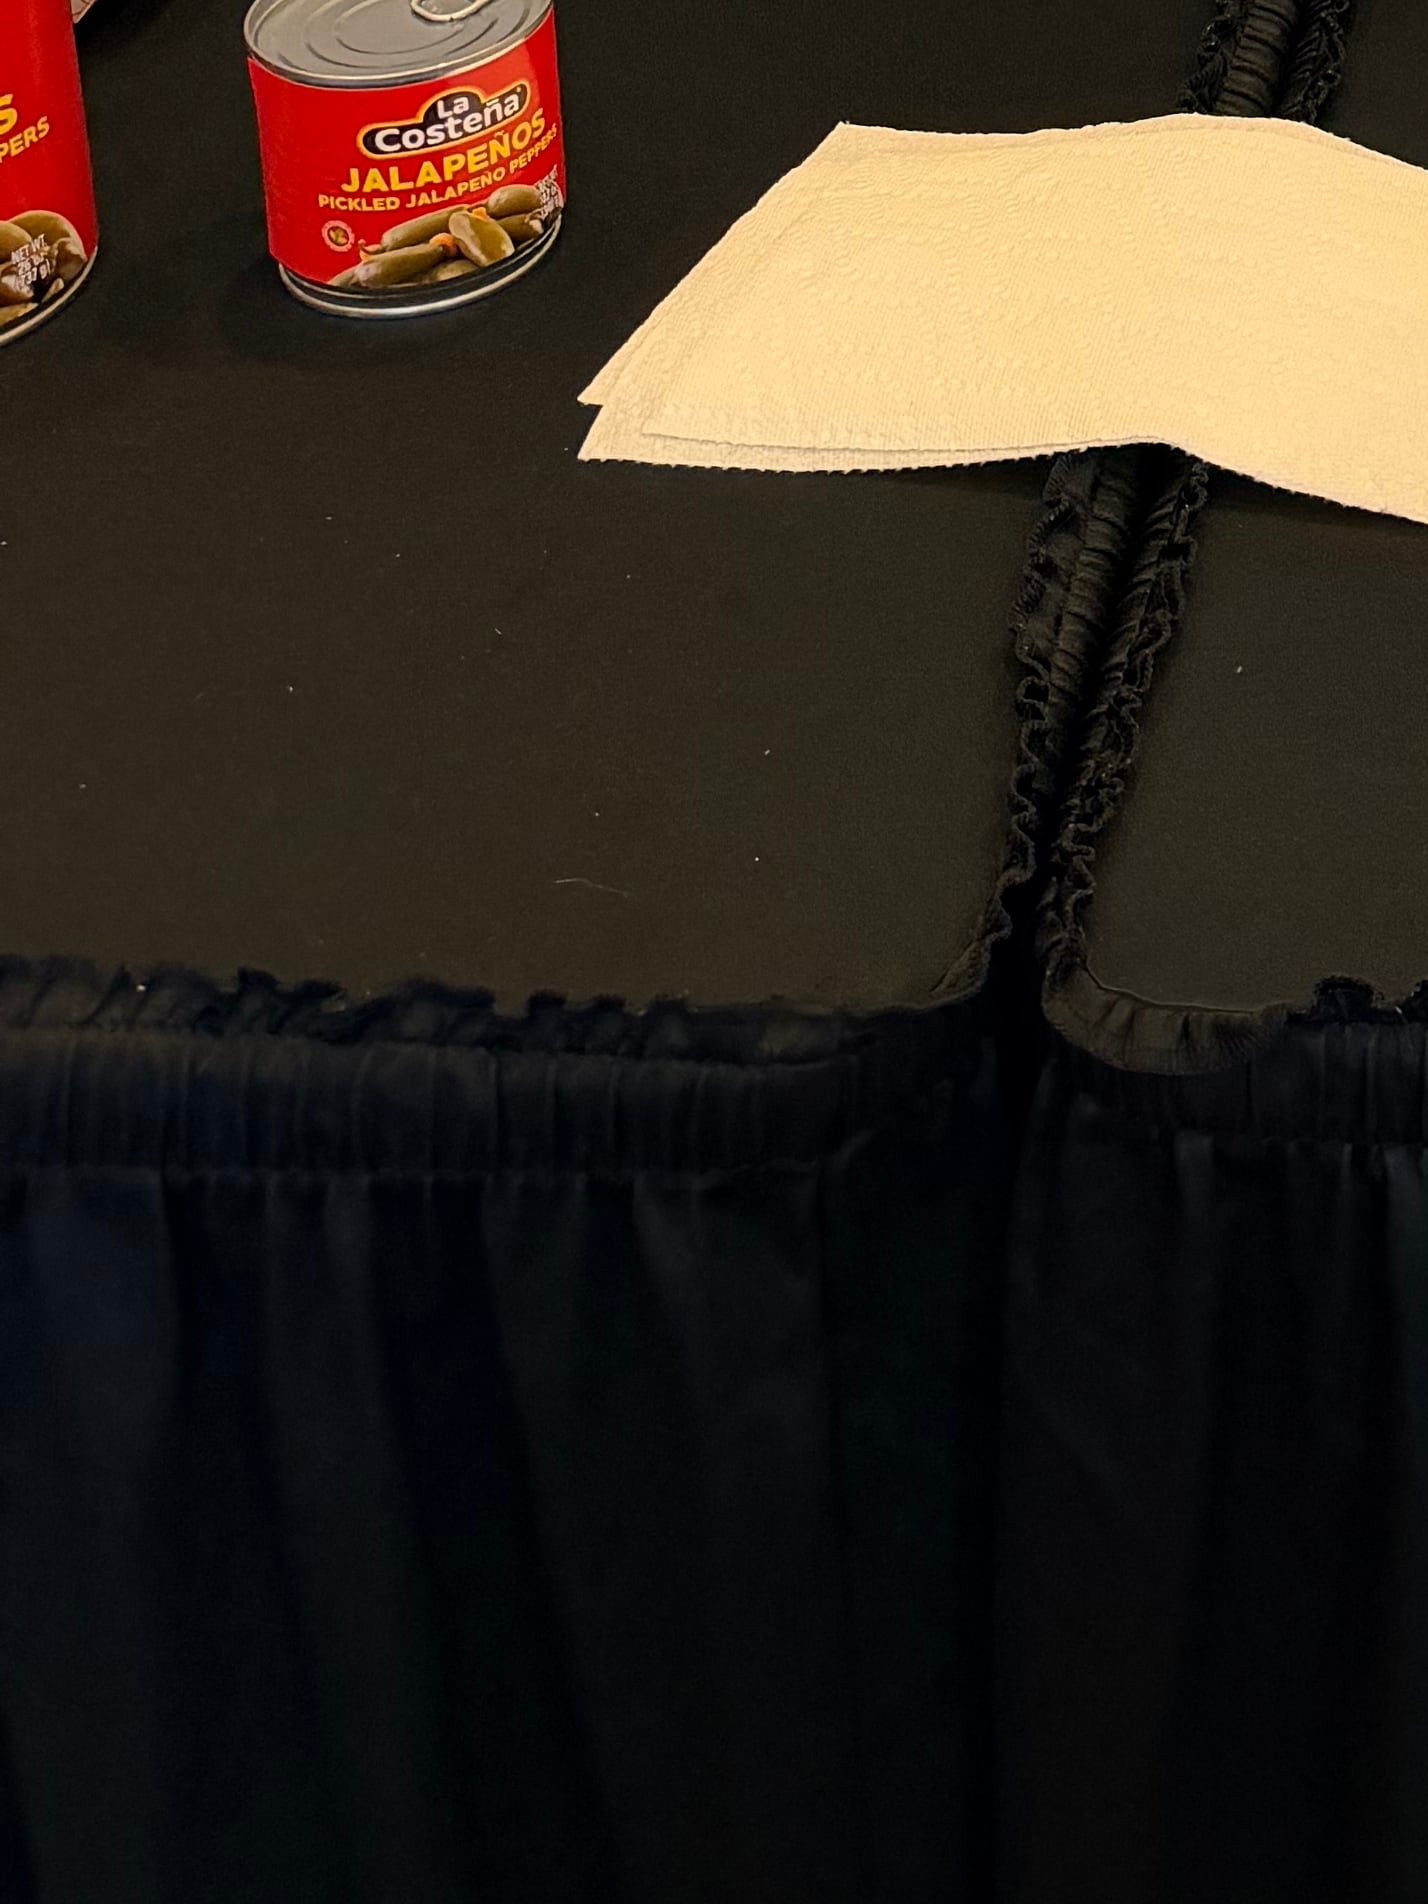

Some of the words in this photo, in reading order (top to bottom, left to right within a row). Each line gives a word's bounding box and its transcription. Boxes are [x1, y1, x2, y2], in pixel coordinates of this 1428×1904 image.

[374, 93, 522, 153] Costeña
[437, 96, 470, 119] La
[318, 193, 401, 212] PICKLED
[405, 166, 506, 209] JALAPEÑO
[509, 122, 558, 175] PEPPERS
[341, 107, 545, 193] JALAPEÑOS
